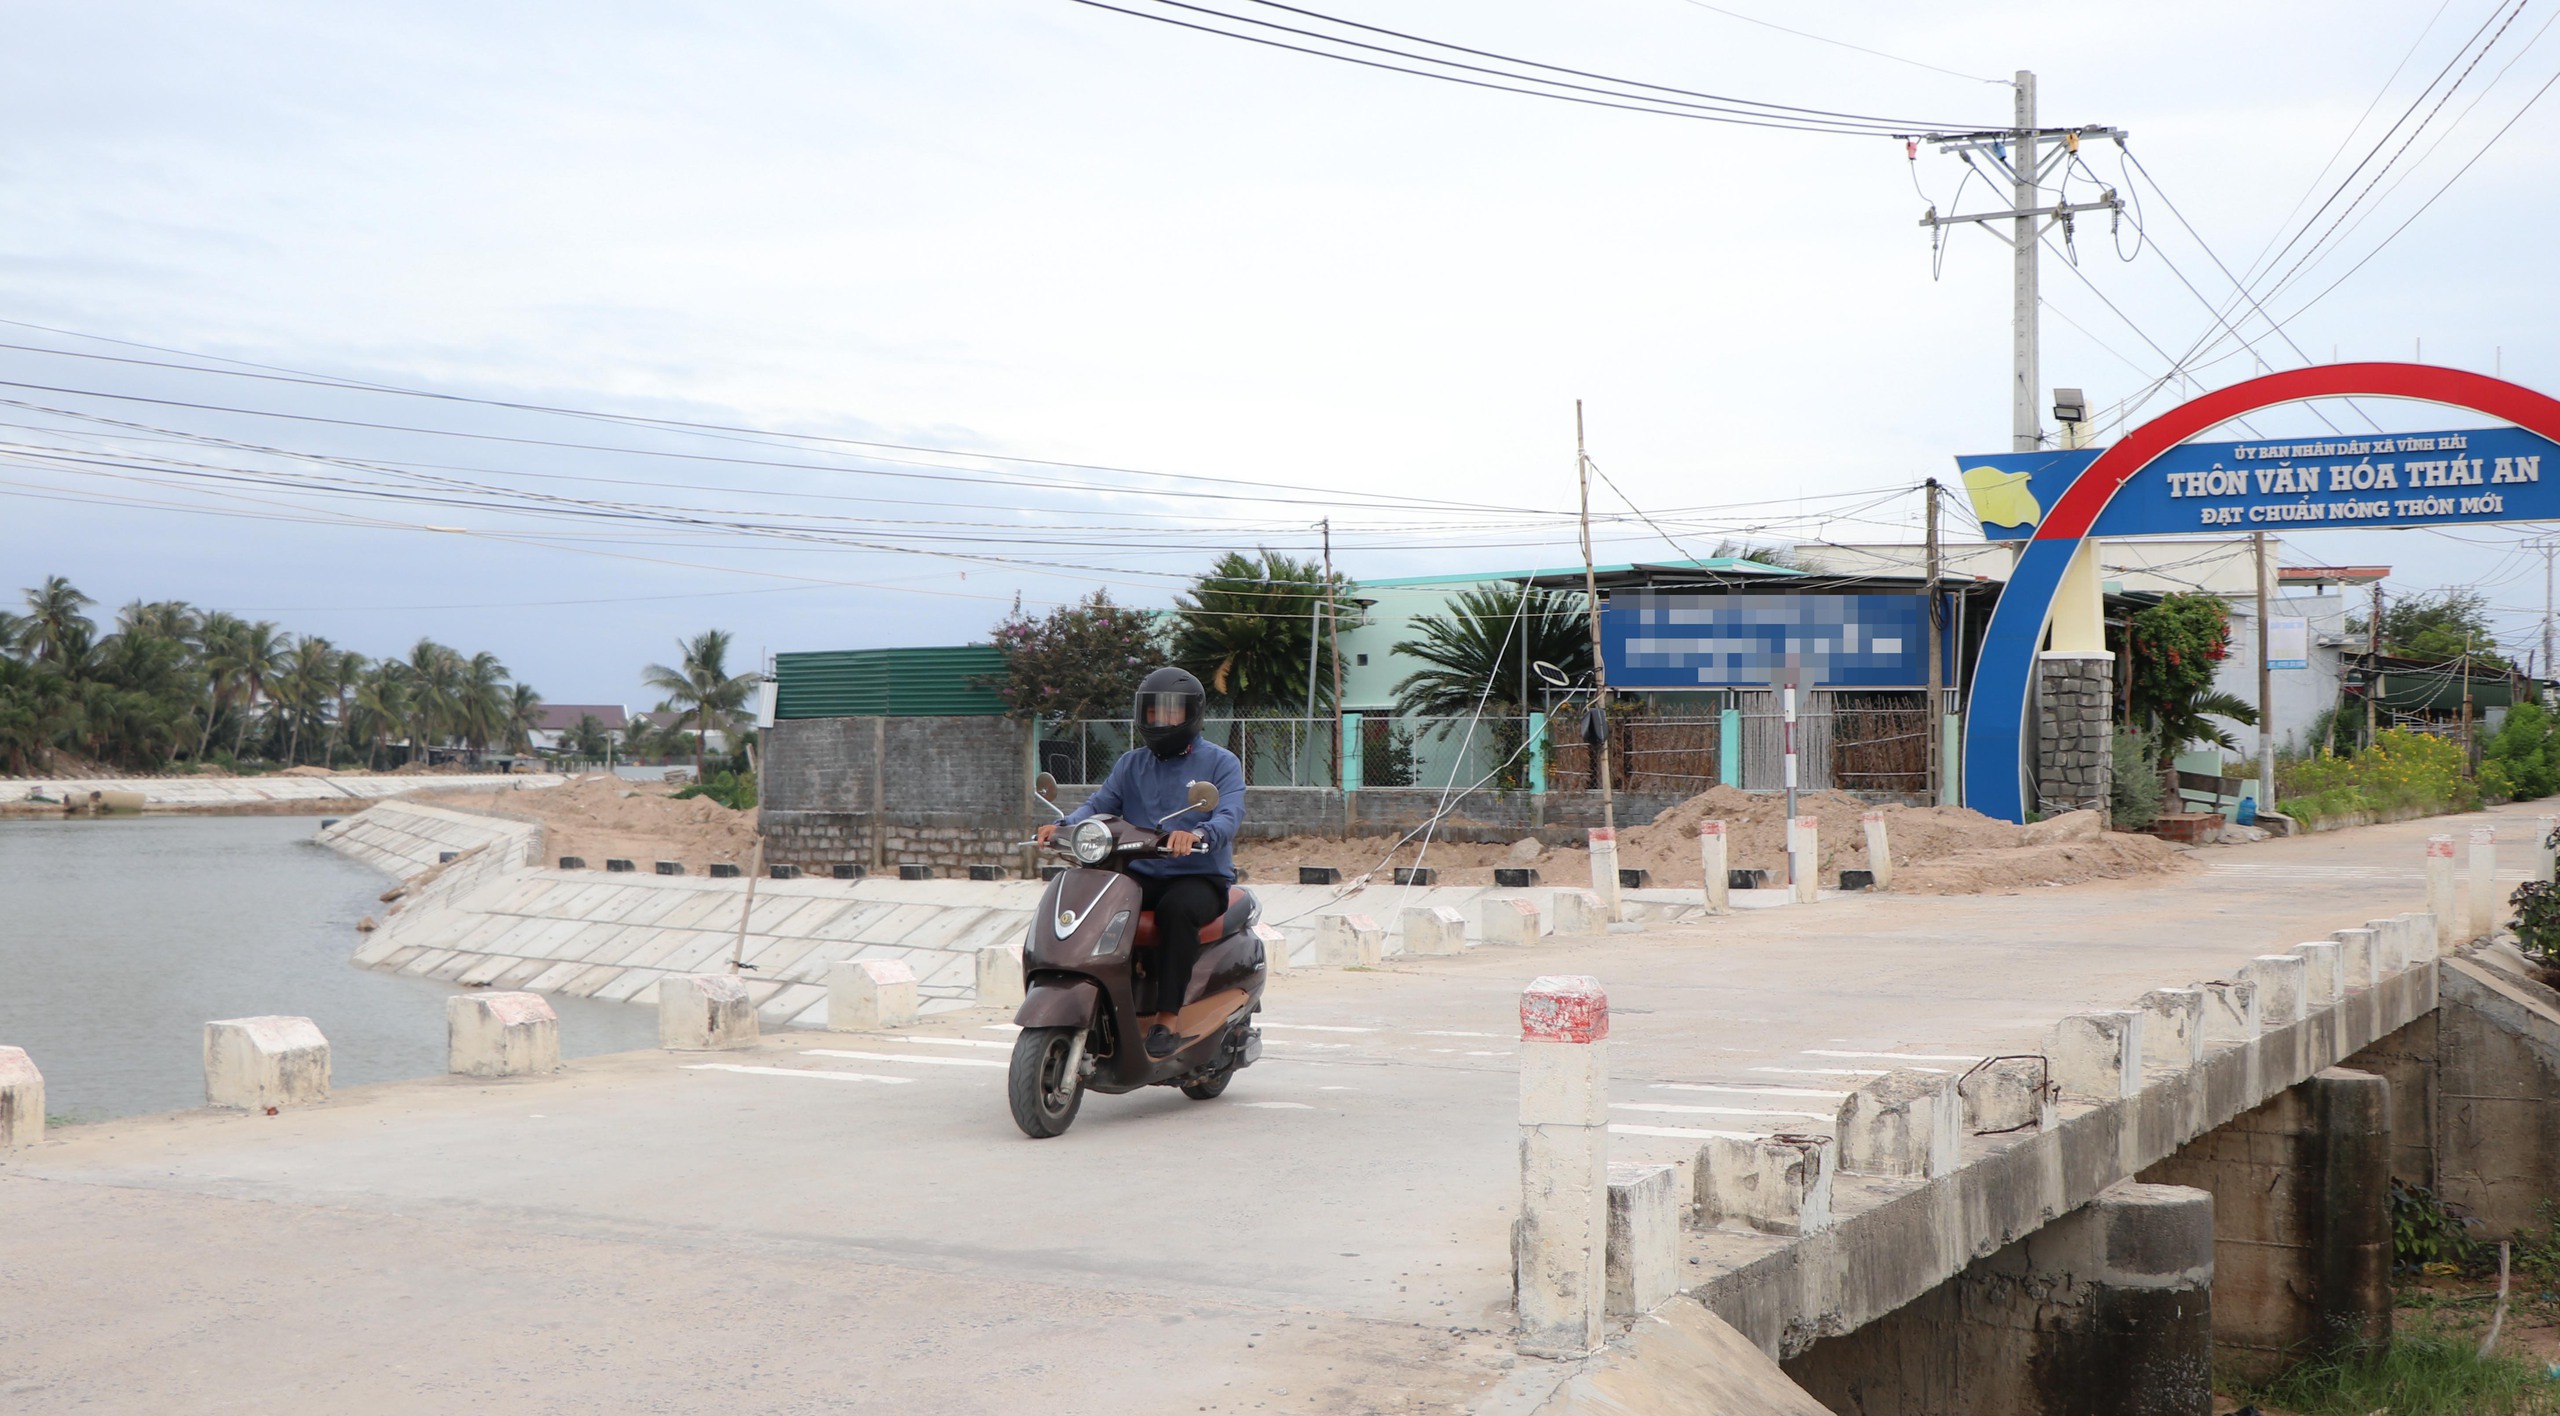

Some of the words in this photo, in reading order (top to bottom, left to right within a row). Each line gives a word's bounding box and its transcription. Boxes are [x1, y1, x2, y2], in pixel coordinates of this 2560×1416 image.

[2259, 446, 2290, 459] BAN
[2292, 442, 2336, 458] NHÂN
[2337, 440, 2371, 455] DÂN
[2372, 438, 2396, 454] XÃ
[2396, 437, 2435, 452] VĨNH
[2438, 433, 2468, 450] HẢI
[2167, 463, 2249, 498] THÔN
[2255, 461, 2321, 494] VĂN
[2329, 456, 2399, 491] HÓA
[2405, 453, 2484, 488] THÁI
[2491, 456, 2541, 484] AN
[2201, 507, 2245, 526] ĐẠT
[2249, 495, 2326, 522] CHUẨN
[2328, 498, 2391, 520] NÔNG
[2395, 495, 2455, 517] THÔN
[2460, 491, 2504, 514] MỚI
